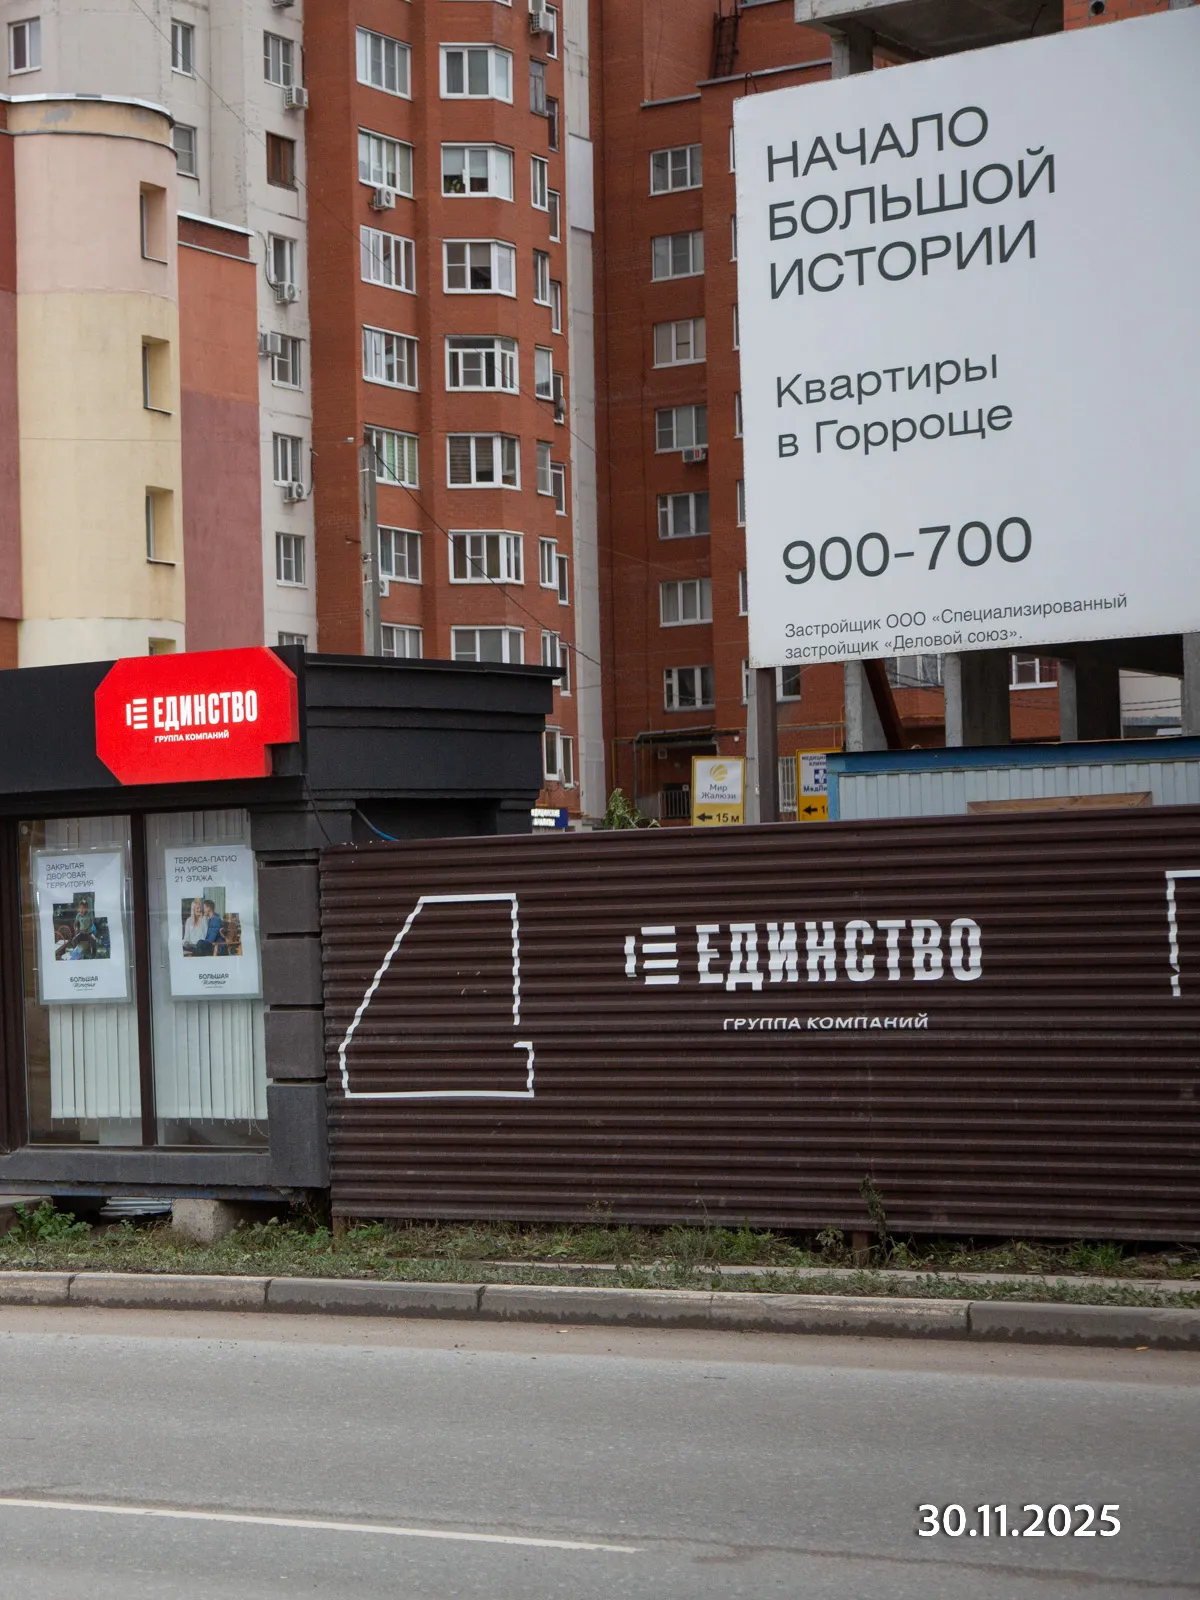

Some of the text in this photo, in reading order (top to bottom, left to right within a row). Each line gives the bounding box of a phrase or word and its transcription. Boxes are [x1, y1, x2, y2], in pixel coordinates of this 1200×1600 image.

[767, 106, 988, 182] НАЧАЛО
[769, 145, 1056, 241] БОЛЬШОЙ
[770, 220, 1036, 300] ИСТОРИИ
[776, 354, 997, 408] Квартиры
[778, 404, 1013, 458] в Горроще
[782, 517, 1032, 585] 900-700
[785, 593, 1127, 638] Застройщик ООО «Специализированный
[785, 629, 1023, 660] застройщик «Деловой союз».
[153, 690, 257, 731] ЕДИНСТВО
[154, 729, 230, 743] ГРУППА КОМПАНИЙ
[701, 792, 736, 800] Жалюзи
[709, 784, 728, 793] Мир
[716, 813, 729, 822] 15
[46, 862, 84, 871] ЗАКРЫТАЯ
[174, 855, 237, 864] ТЕРРАСА-ПАТИО
[46, 871, 86, 880] ДВОРОВАЯ
[46, 880, 94, 888] ТЕРРИТОРИЯ
[186, 875, 213, 883] ЭТАЖА
[696, 918, 983, 991] ЕДИНСТВО
[723, 1012, 929, 1031] ГРУППА КОМПАНИЙ
